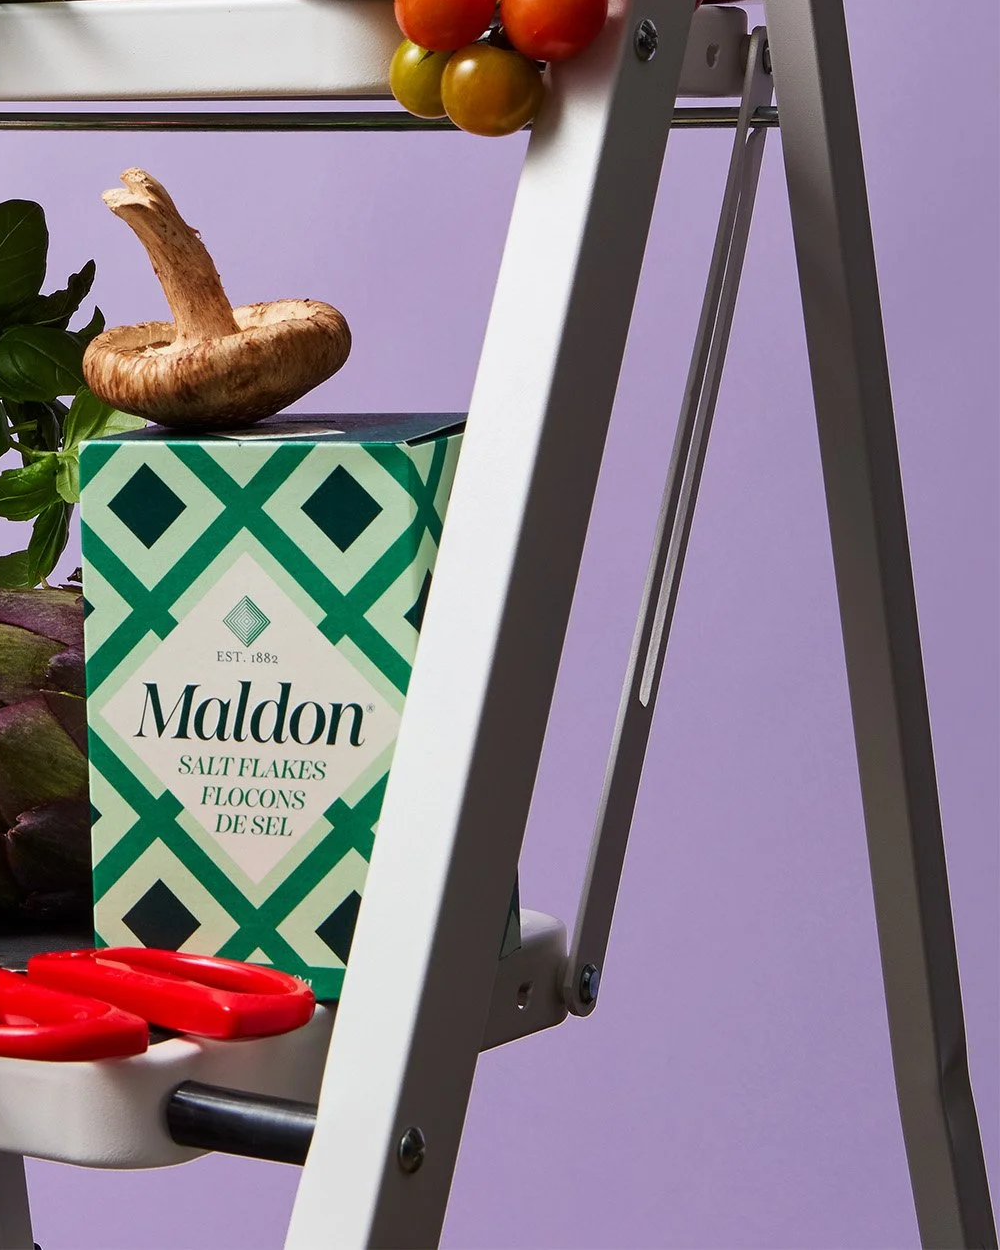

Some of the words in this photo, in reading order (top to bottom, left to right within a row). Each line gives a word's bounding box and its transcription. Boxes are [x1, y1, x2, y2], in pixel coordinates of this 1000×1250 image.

[216, 650, 247, 664] EST.
[250, 651, 279, 665] 1882
[132, 679, 366, 748] Maldon
[177, 754, 236, 777] SALT
[238, 757, 327, 781] FLAKES
[199, 785, 307, 811] FLOCONS
[214, 813, 248, 835] DE
[250, 815, 294, 837] SEL
